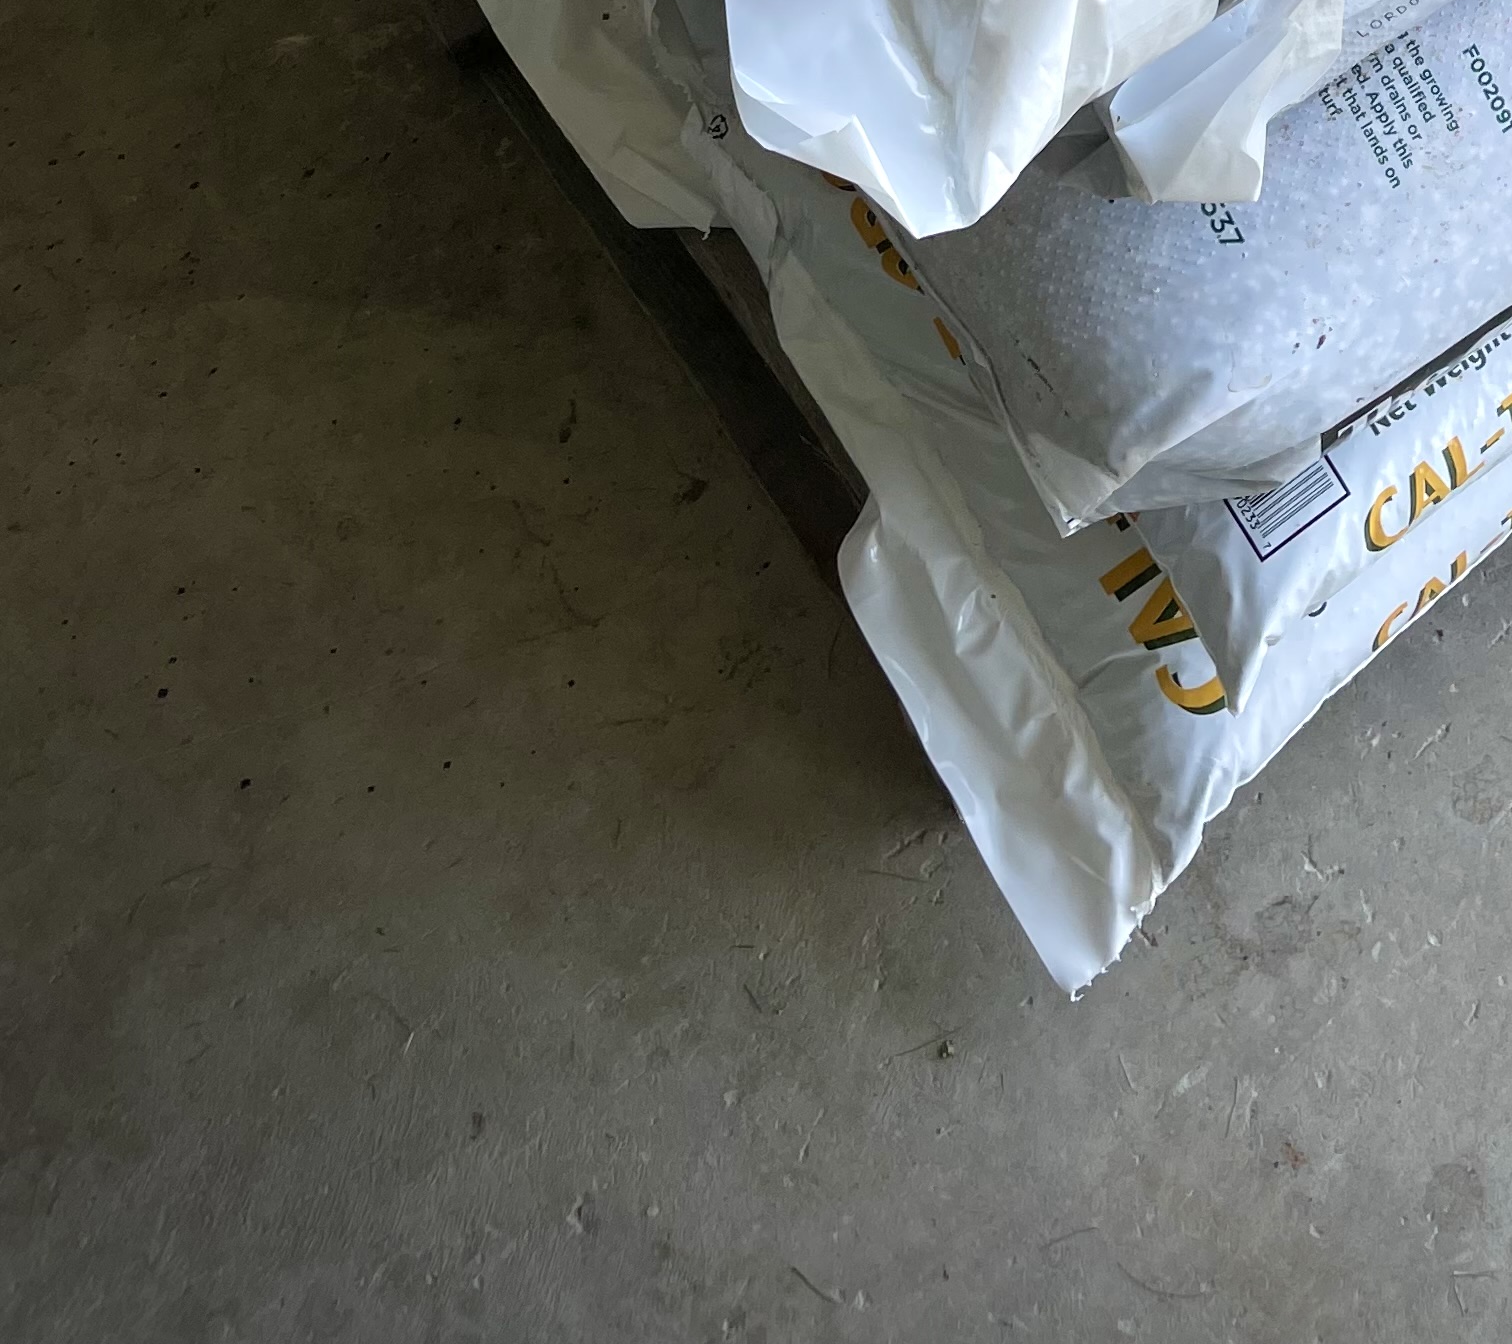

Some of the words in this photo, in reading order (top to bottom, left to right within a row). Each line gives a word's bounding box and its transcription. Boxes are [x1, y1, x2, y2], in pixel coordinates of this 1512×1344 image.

[1379, 73, 1412, 125] drains
[1407, 122, 1424, 142] or
[1384, 42, 1396, 56] a
[1391, 55, 1436, 124] qualified
[1405, 39, 1426, 68] the
[1418, 64, 1461, 133] growing
[1341, 86, 1365, 123] that
[1360, 120, 1390, 168] lands
[1384, 166, 1403, 190] on
[1365, 90, 1400, 138] Apply
[1391, 136, 1415, 170] this
[1200, 202, 1246, 245] 537
[1368, 393, 1419, 436] Net
